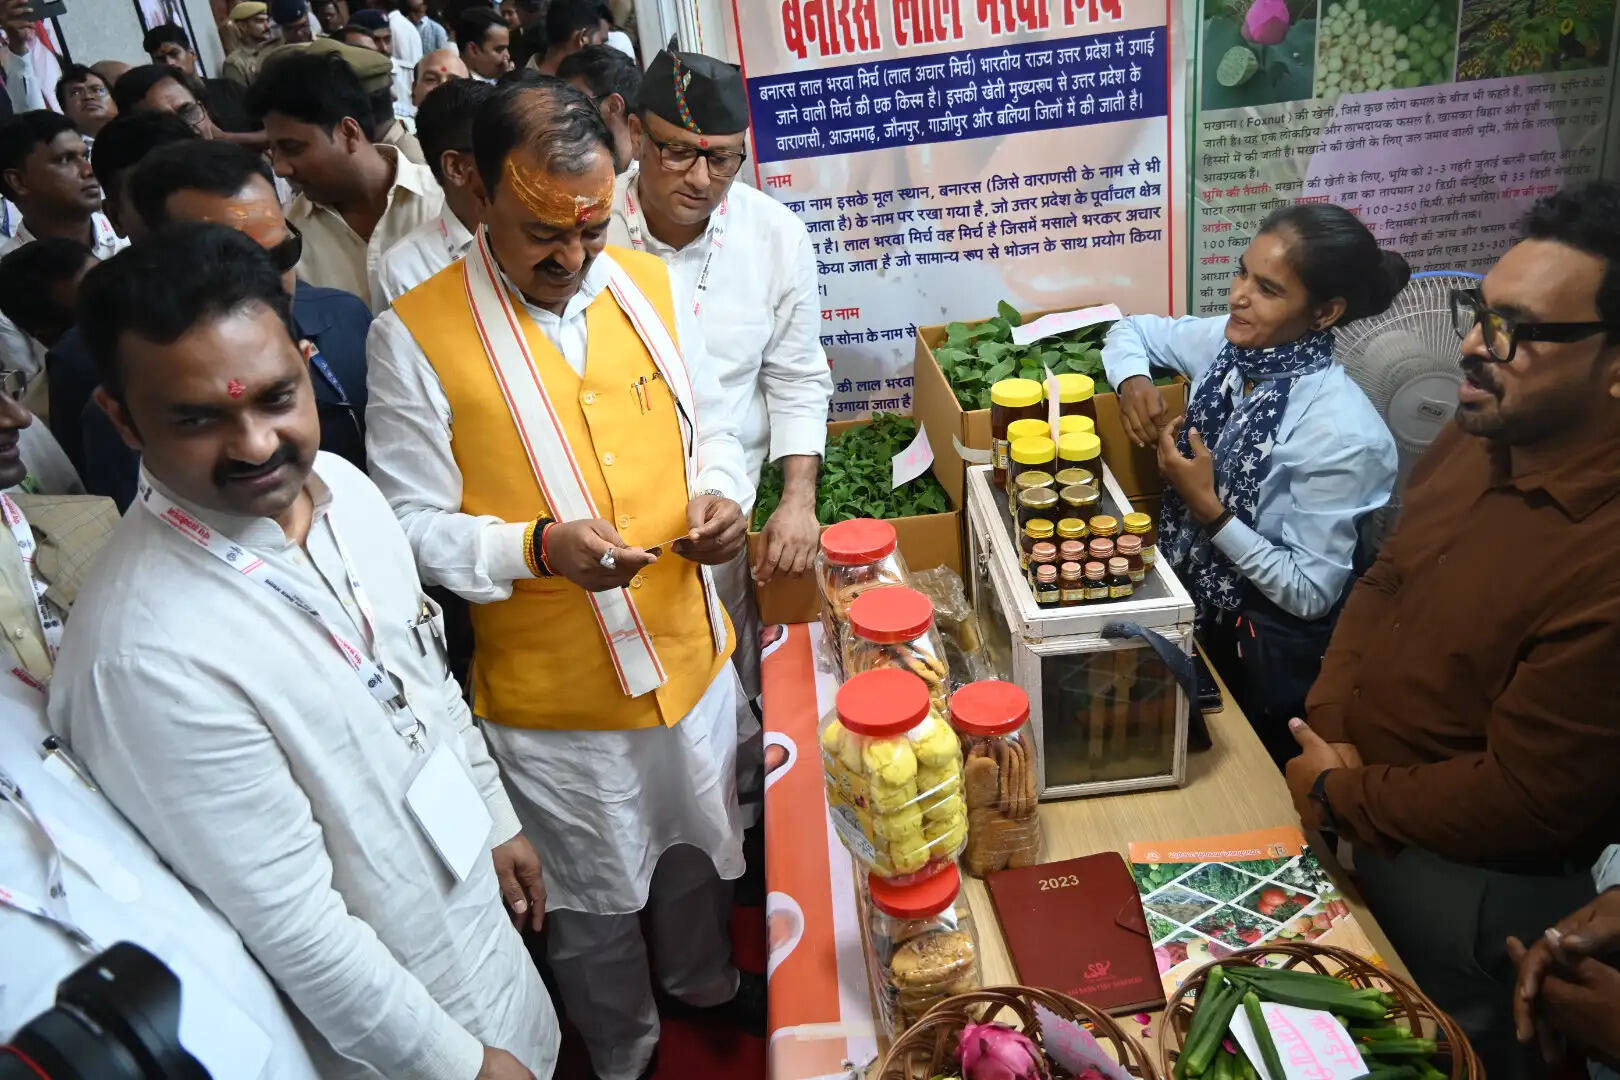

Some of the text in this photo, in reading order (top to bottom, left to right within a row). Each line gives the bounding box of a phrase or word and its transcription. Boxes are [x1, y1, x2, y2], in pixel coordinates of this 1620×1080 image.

[759, 31, 1154, 100] बनारस लाल भरवा मिर्च (लाल अचार मिर्च) भारतीय राज्य उत्तर प्रदेश में उगाई
[776, 62, 1141, 124] जाने वाली मिर्च की एक किस्म है। इसकी खेती मुख्यरूप से उत्तर प्रदेश के
[776, 90, 1142, 151] वाराणसी, आजमगढ़, जौनपुर, गाजीपुर और बलिया जिलों में की जाती है।
[1203, 88, 1485, 131] मखाना Foxnut की खेती, जिसे कुछ लोग कमल के भी
[1203, 119, 1394, 148] जाती यह एक लोकप्रिय और लाभदायक
[1244, 147, 1258, 161] की
[1261, 145, 1283, 159] जाती
[1297, 141, 1327, 155] मखाने
[1330, 140, 1343, 151] की
[1345, 137, 1366, 150] खेती
[1369, 135, 1379, 146] के
[1383, 134, 1403, 146] लिए
[766, 175, 792, 188] नाम
[809, 198, 832, 210] नाम
[837, 190, 868, 210] इसके
[872, 191, 893, 208] मूल
[897, 187, 934, 200] स्थान,
[939, 182, 981, 196] बनारस
[987, 173, 1019, 192] (जिसे
[1024, 166, 1076, 187] वाराणसी
[1081, 165, 1095, 180] के
[1099, 165, 1123, 178] नाम
[1128, 159, 1140, 175] से
[1146, 157, 1160, 172] भी
[1204, 170, 1247, 183] आवश्यक
[1275, 178, 1305, 192] मखाने
[1307, 176, 1321, 190] की
[1324, 173, 1345, 187] खेती
[1347, 172, 1358, 183] के
[1389, 167, 1409, 182] भूमि
[1411, 164, 1424, 176] को
[1427, 164, 1446, 175] 2-3
[805, 181, 1161, 232] जाता है) के नाम पर रखा गया है, जो उत्तर प्रदेश के पूर्वांचल क्षेत्र
[1201, 205, 1223, 216] पाटा
[1226, 204, 1256, 216] लगाना
[1361, 189, 1375, 198] का
[1379, 185, 1415, 197] तापमान
[1418, 184, 1432, 195] 20
[1367, 202, 1417, 215] 100-250
[823, 238, 838, 254] है।
[843, 238, 869, 251] लाल
[874, 234, 904, 247] भरवा
[908, 227, 932, 243] मिर्च
[936, 230, 955, 242] वह
[958, 222, 983, 240] मिर्च
[987, 221, 997, 238] है
[1000, 216, 1037, 235] जिसमें
[1041, 212, 1077, 229] मसाले
[1082, 211, 1121, 225] भरकर
[1126, 207, 1161, 221] अचार
[1203, 240, 1225, 249] 100
[848, 259, 877, 272] जाता
[882, 253, 891, 269] है
[895, 251, 911, 266] जो
[915, 251, 959, 264] सामान्य
[963, 249, 983, 261] रूप
[987, 243, 999, 259] से
[1004, 241, 1039, 256] भोजन
[1044, 237, 1056, 251] के
[1060, 237, 1087, 250] साथ
[1092, 231, 1125, 247] प्रयोग
[1129, 228, 1161, 243] किया
[835, 308, 860, 320] नाम
[836, 330, 863, 344] सोना
[866, 328, 878, 342] के
[881, 329, 903, 340] नाम
[905, 323, 916, 337] से
[836, 376, 914, 392] की लाल भरवा
[836, 400, 869, 412] उगाया
[871, 398, 900, 410] जाता
[901, 392, 911, 408] है
[1039, 874, 1080, 891] 2023
